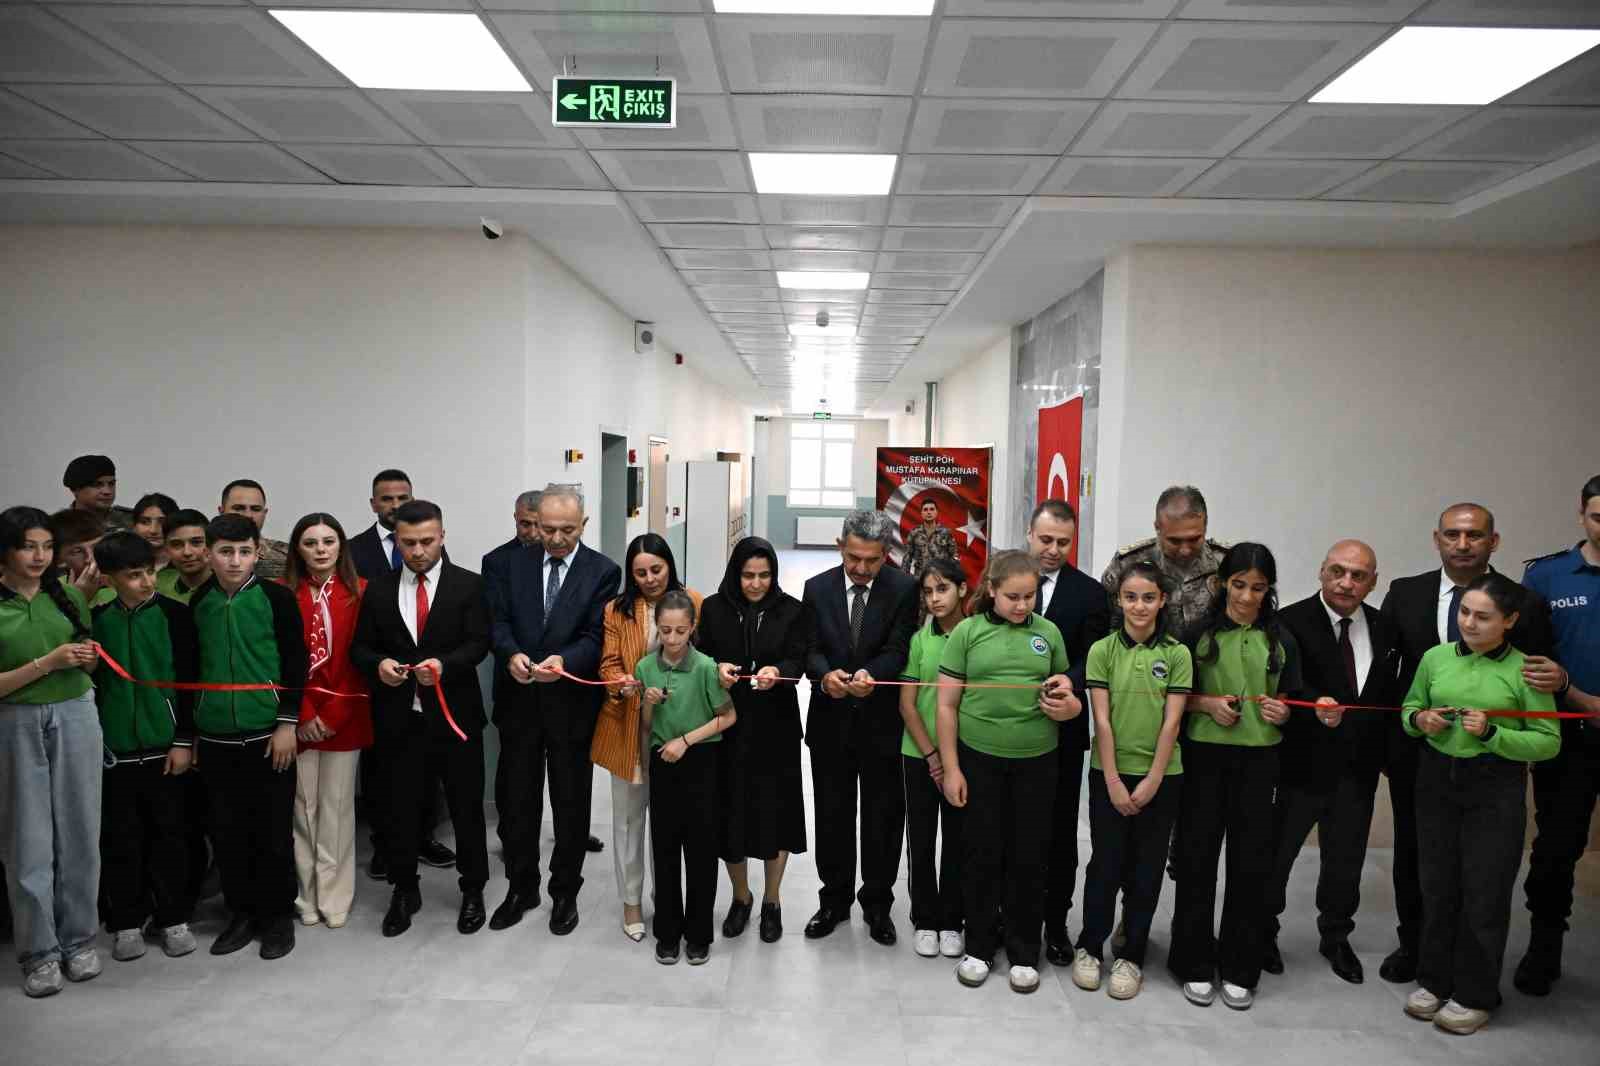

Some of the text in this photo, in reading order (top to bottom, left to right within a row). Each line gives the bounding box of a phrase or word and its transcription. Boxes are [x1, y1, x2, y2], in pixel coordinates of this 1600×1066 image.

[624, 89, 665, 102] EXIT
[623, 103, 665, 118] ÇIKIŞ
[885, 465, 926, 474] MUSTAFA
